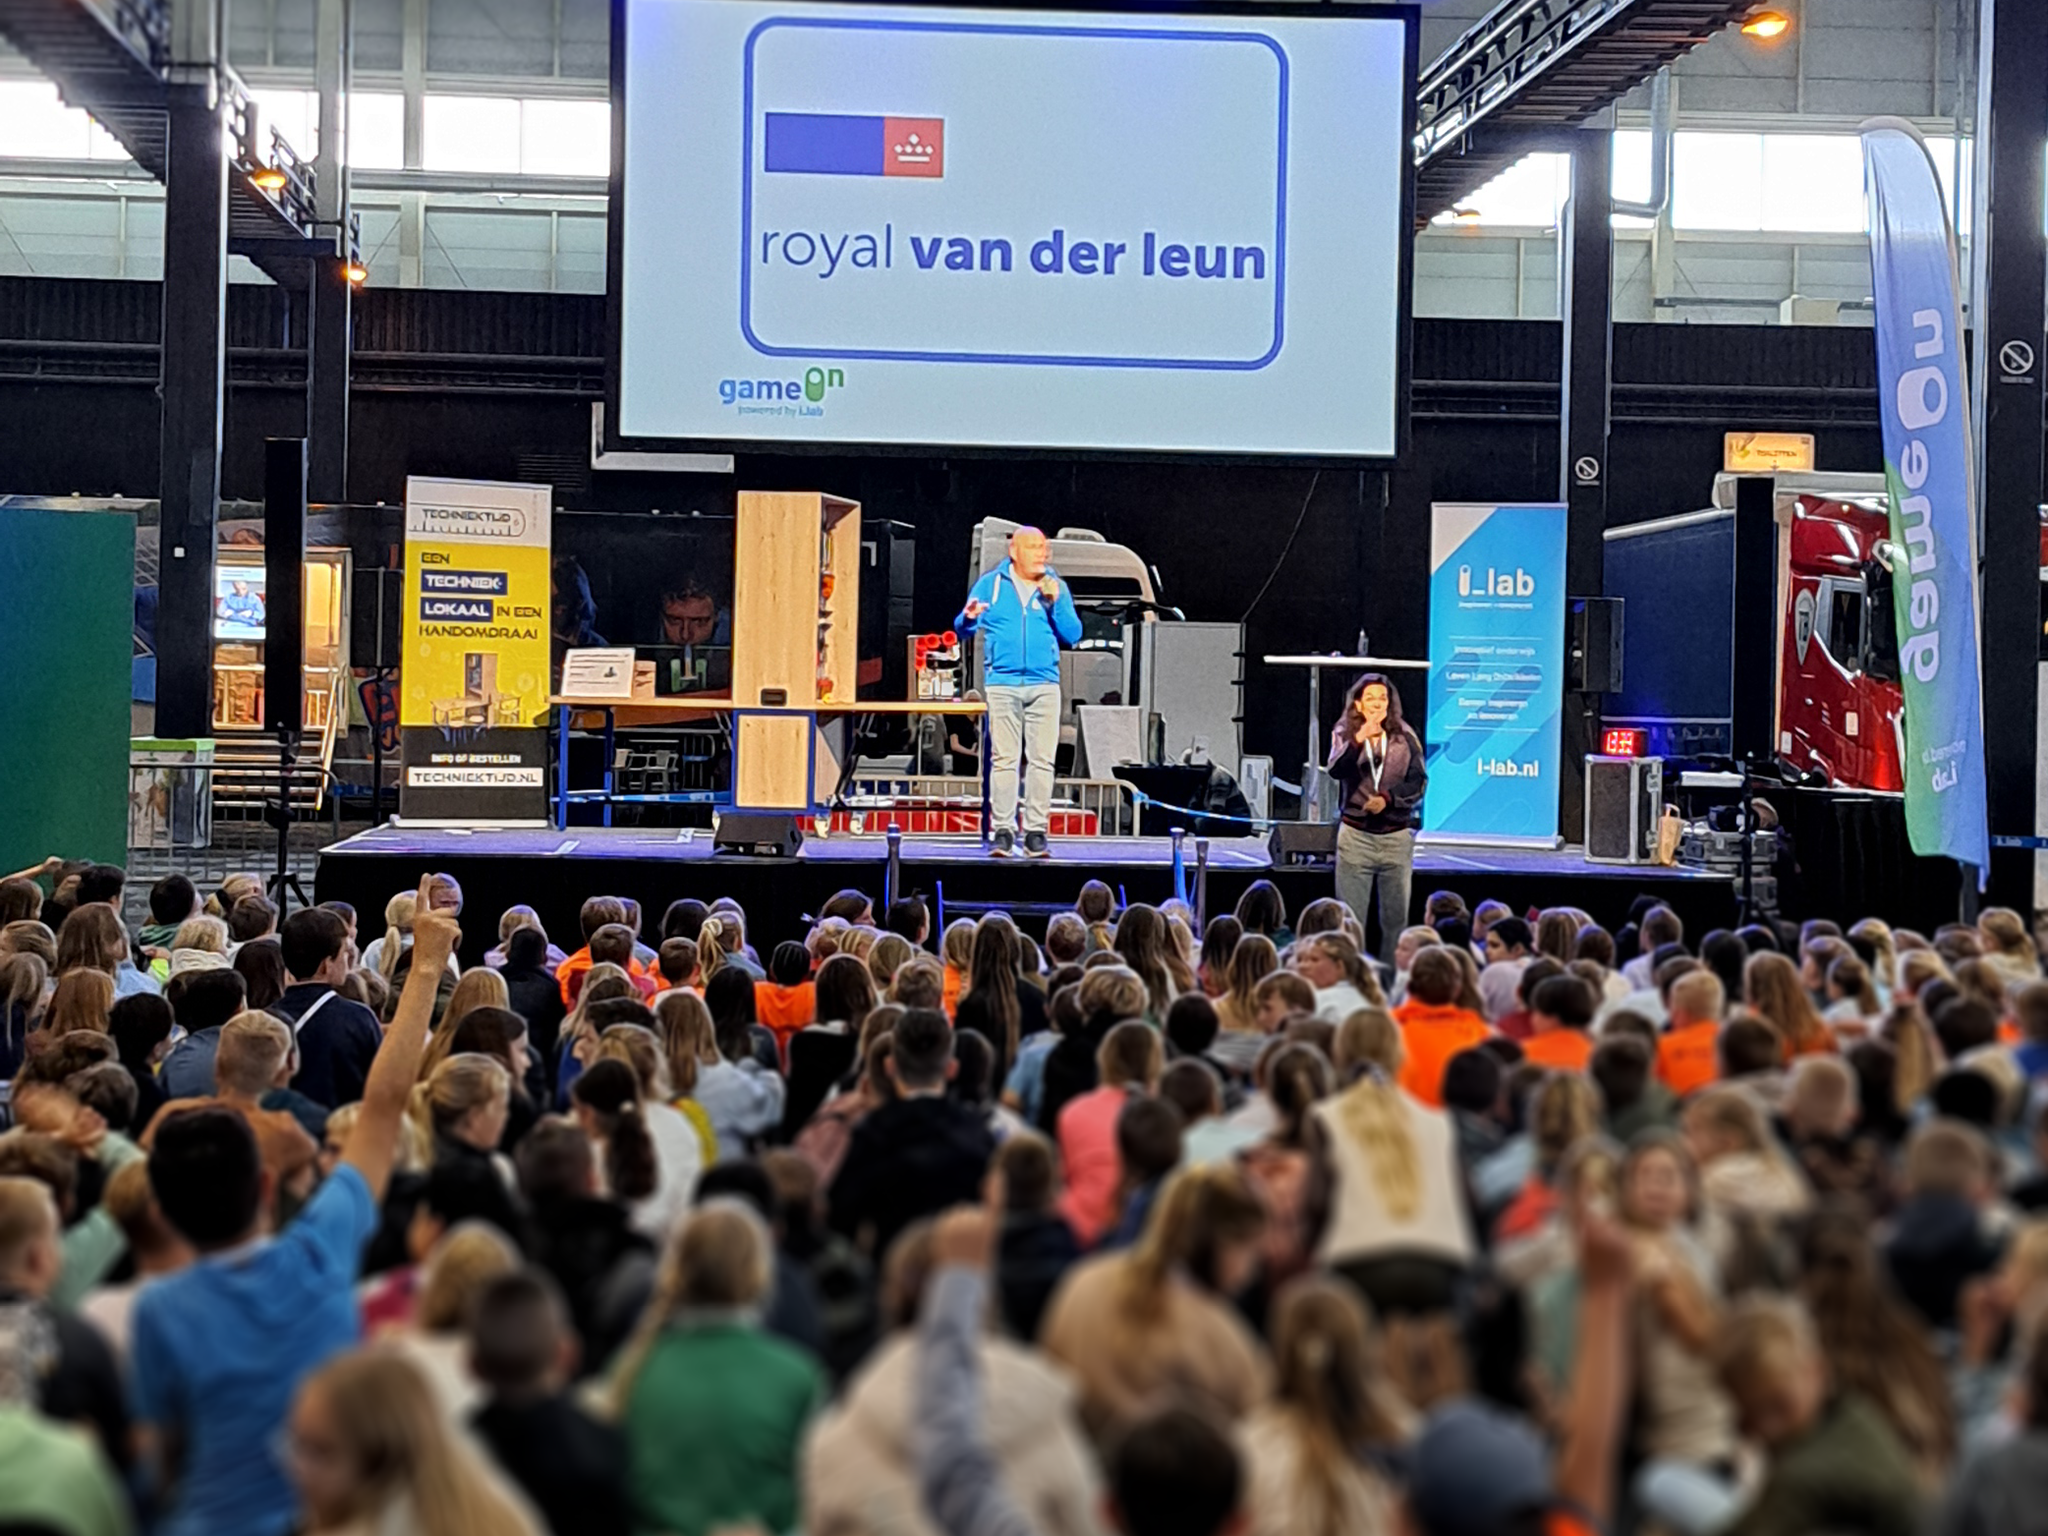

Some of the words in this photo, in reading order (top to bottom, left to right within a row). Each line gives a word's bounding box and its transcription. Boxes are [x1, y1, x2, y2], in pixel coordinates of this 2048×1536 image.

[762, 223, 891, 279] royal
[910, 235, 1012, 271] van
[1030, 229, 1126, 275] der
[1143, 232, 1265, 279] leun
[421, 552, 450, 564] EEN
[424, 602, 490, 617] LOKAAL
[496, 606, 510, 617] IN
[513, 606, 542, 618] EEN
[419, 625, 538, 640] HANDOMDRAAI
[414, 772, 538, 783] TECHNIEKTIJD.NL
